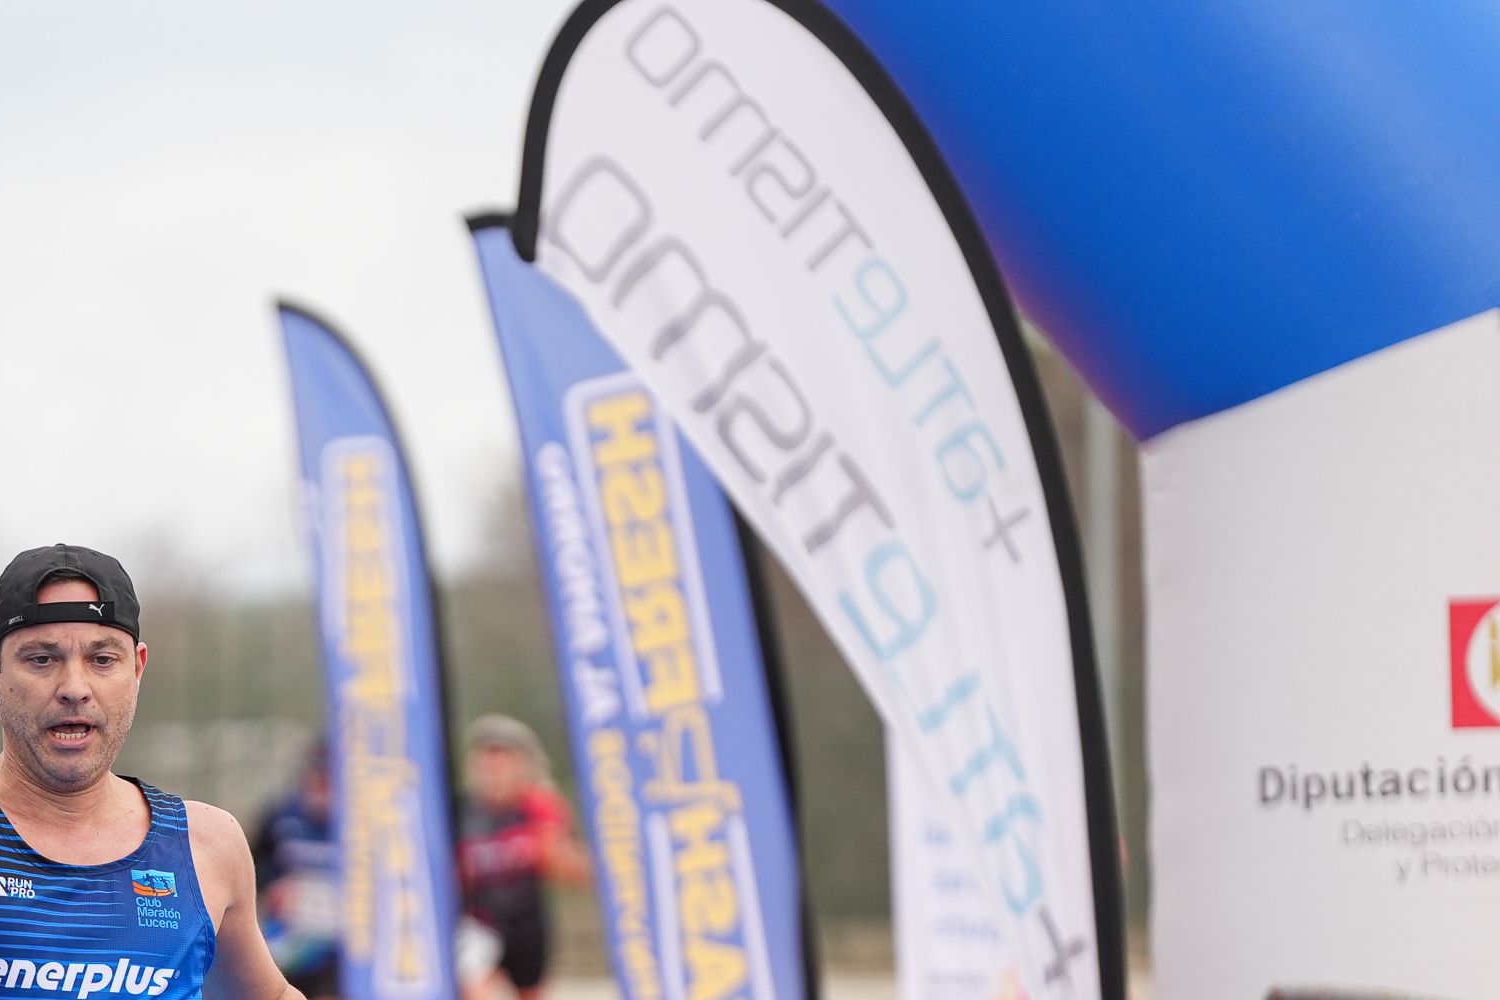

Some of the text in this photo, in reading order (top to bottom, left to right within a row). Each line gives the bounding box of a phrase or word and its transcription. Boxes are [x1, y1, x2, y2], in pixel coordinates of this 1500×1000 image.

[1257, 754, 1500, 811] Diputación
[7, 877, 33, 889] RUN
[11, 887, 36, 899] PRO
[135, 896, 162, 908] Club
[136, 906, 181, 920] Maratón
[137, 916, 179, 930] Lucena
